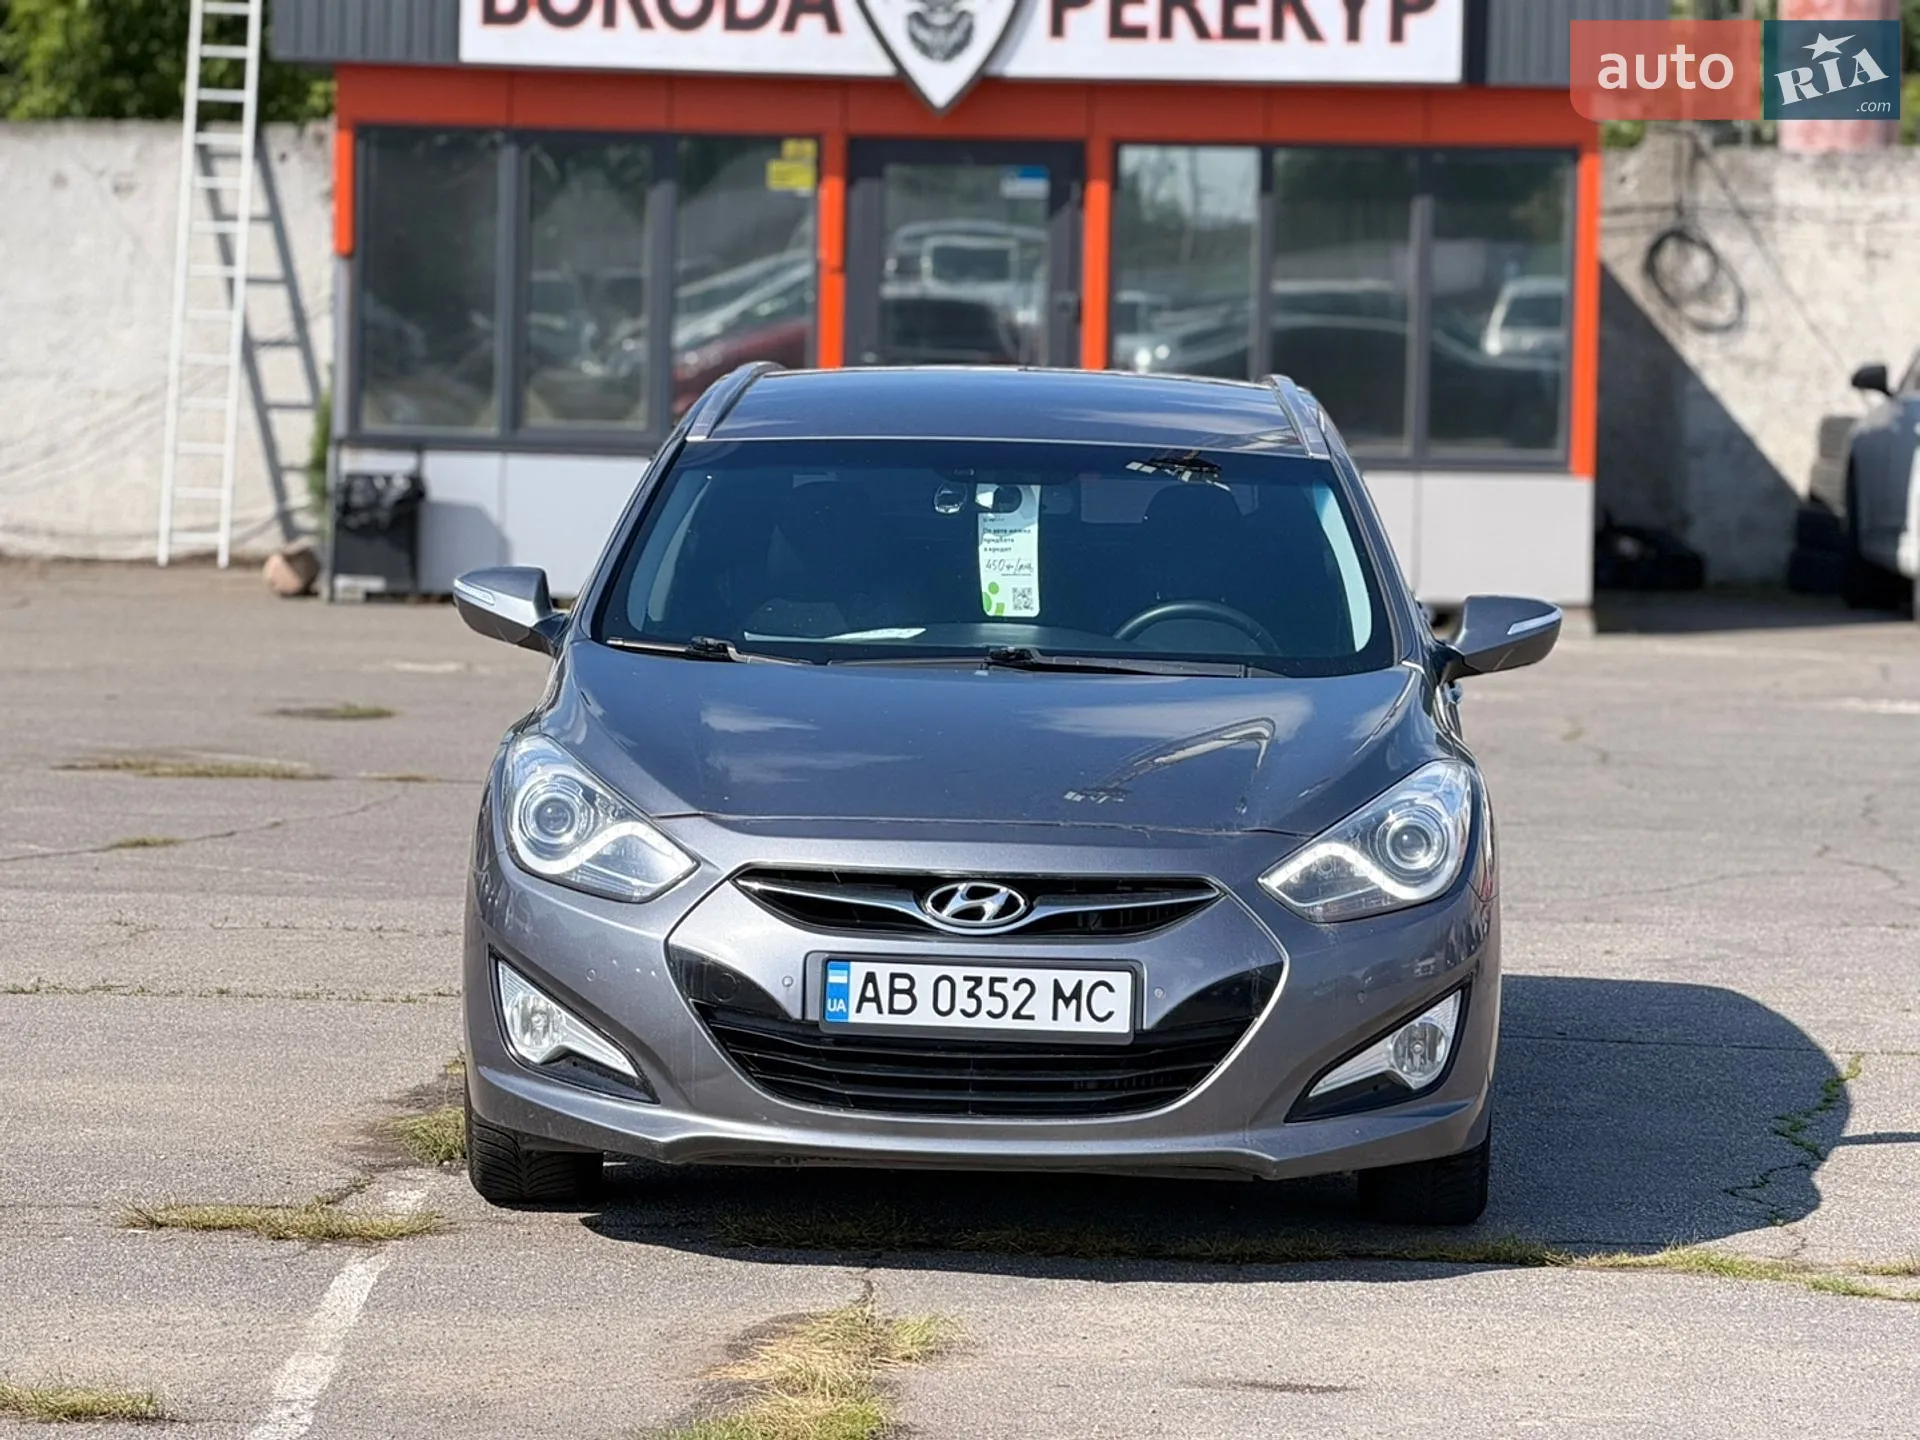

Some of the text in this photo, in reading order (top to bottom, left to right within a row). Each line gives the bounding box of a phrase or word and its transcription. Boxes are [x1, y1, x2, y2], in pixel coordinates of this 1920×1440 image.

[827, 998, 846, 1013] UA
[855, 971, 1115, 1023] AB 0352 MC
